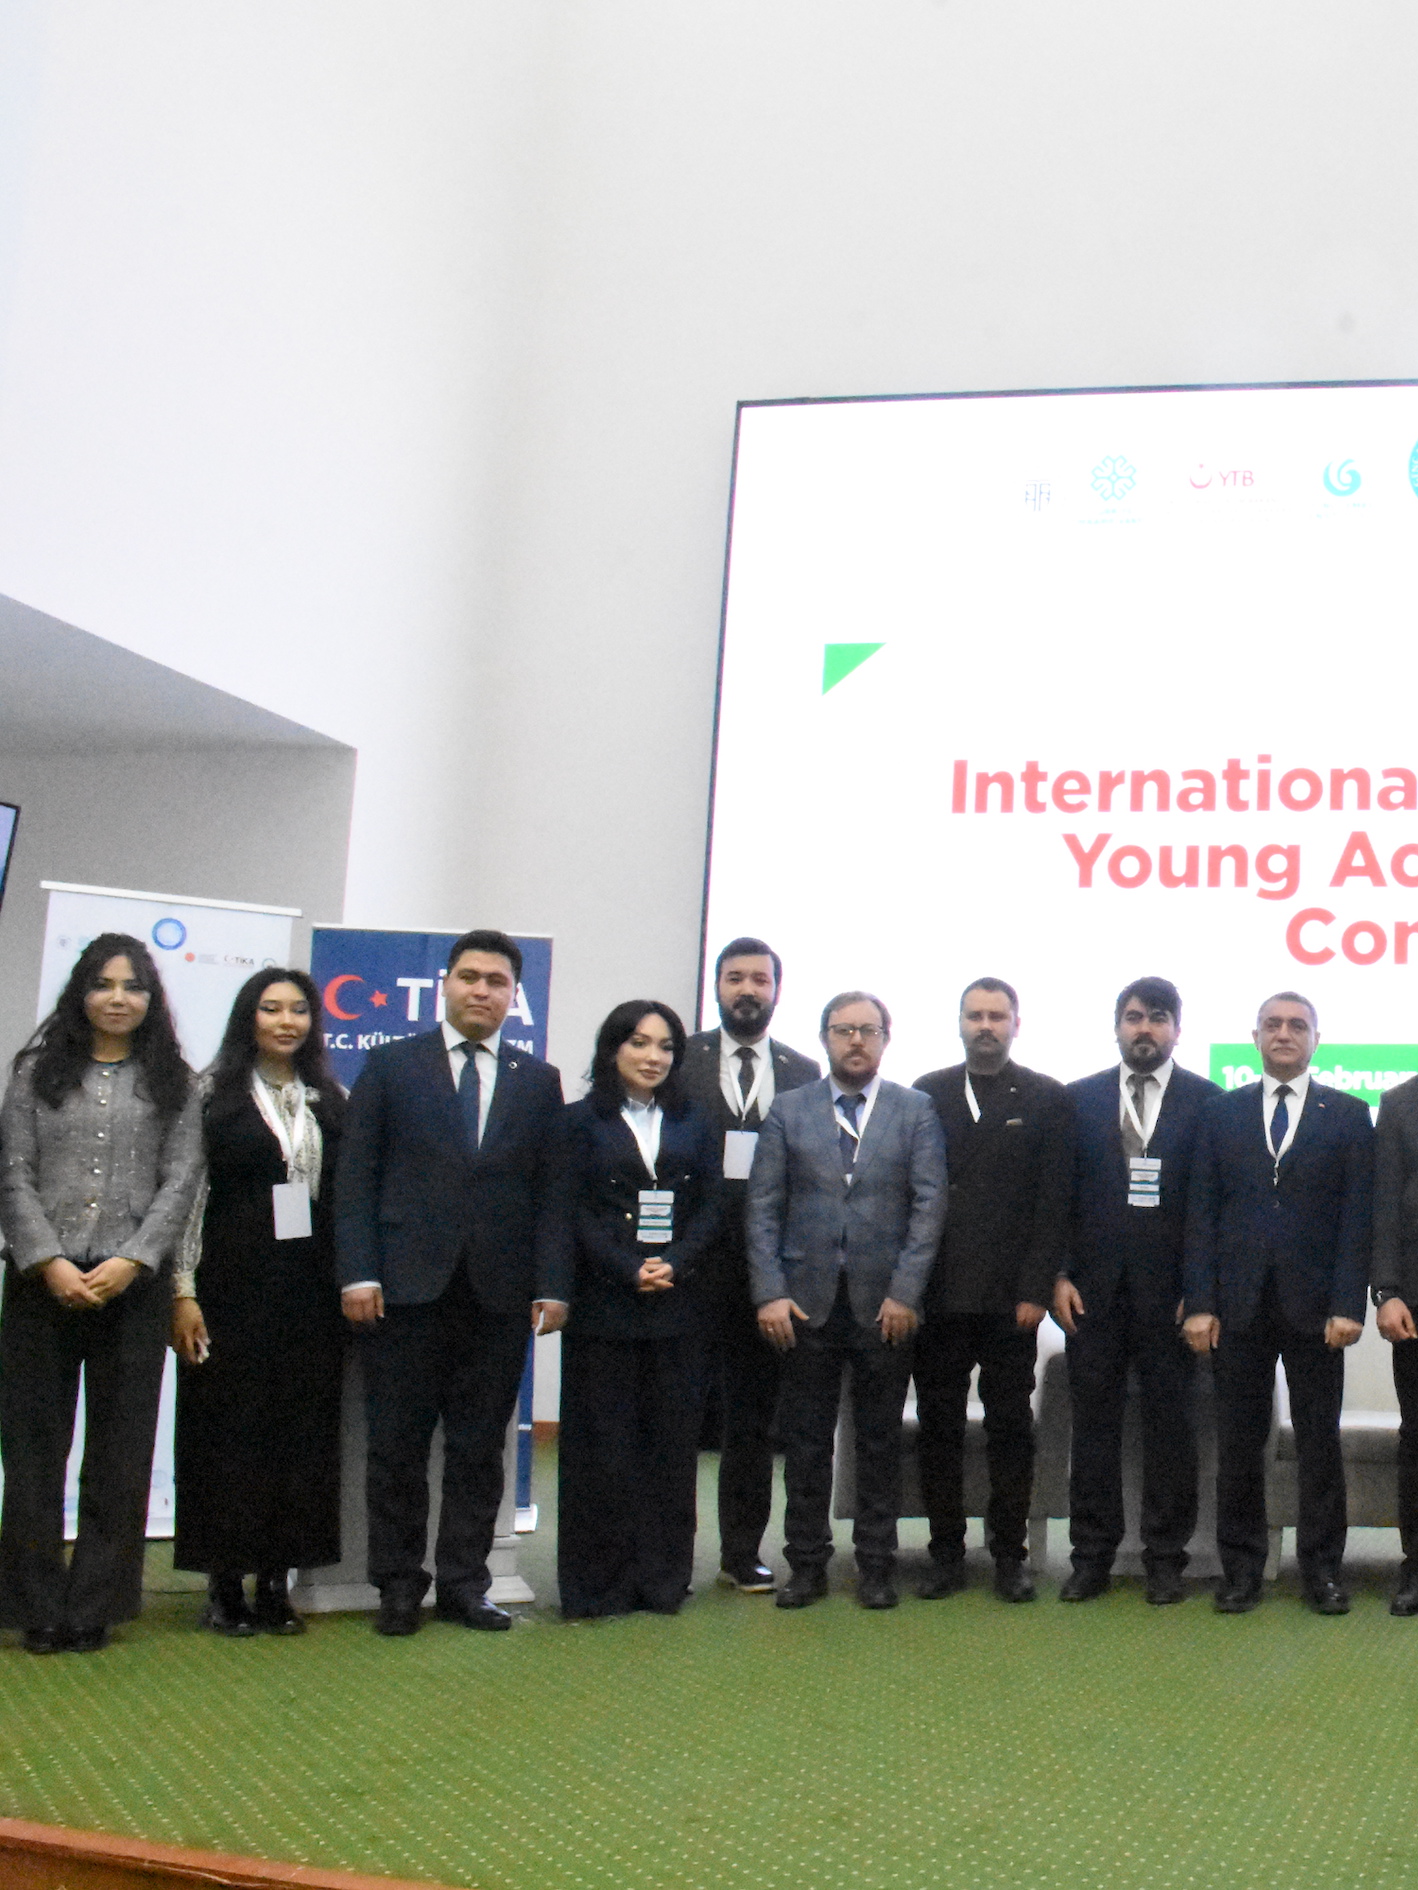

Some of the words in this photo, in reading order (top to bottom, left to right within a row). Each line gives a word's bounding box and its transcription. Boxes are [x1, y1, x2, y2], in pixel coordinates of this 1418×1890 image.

[1218, 469, 1255, 487] YTB
[1062, 832, 1301, 901] Young
[396, 968, 534, 1026] TİA
[322, 1032, 354, 1050] T.C.
